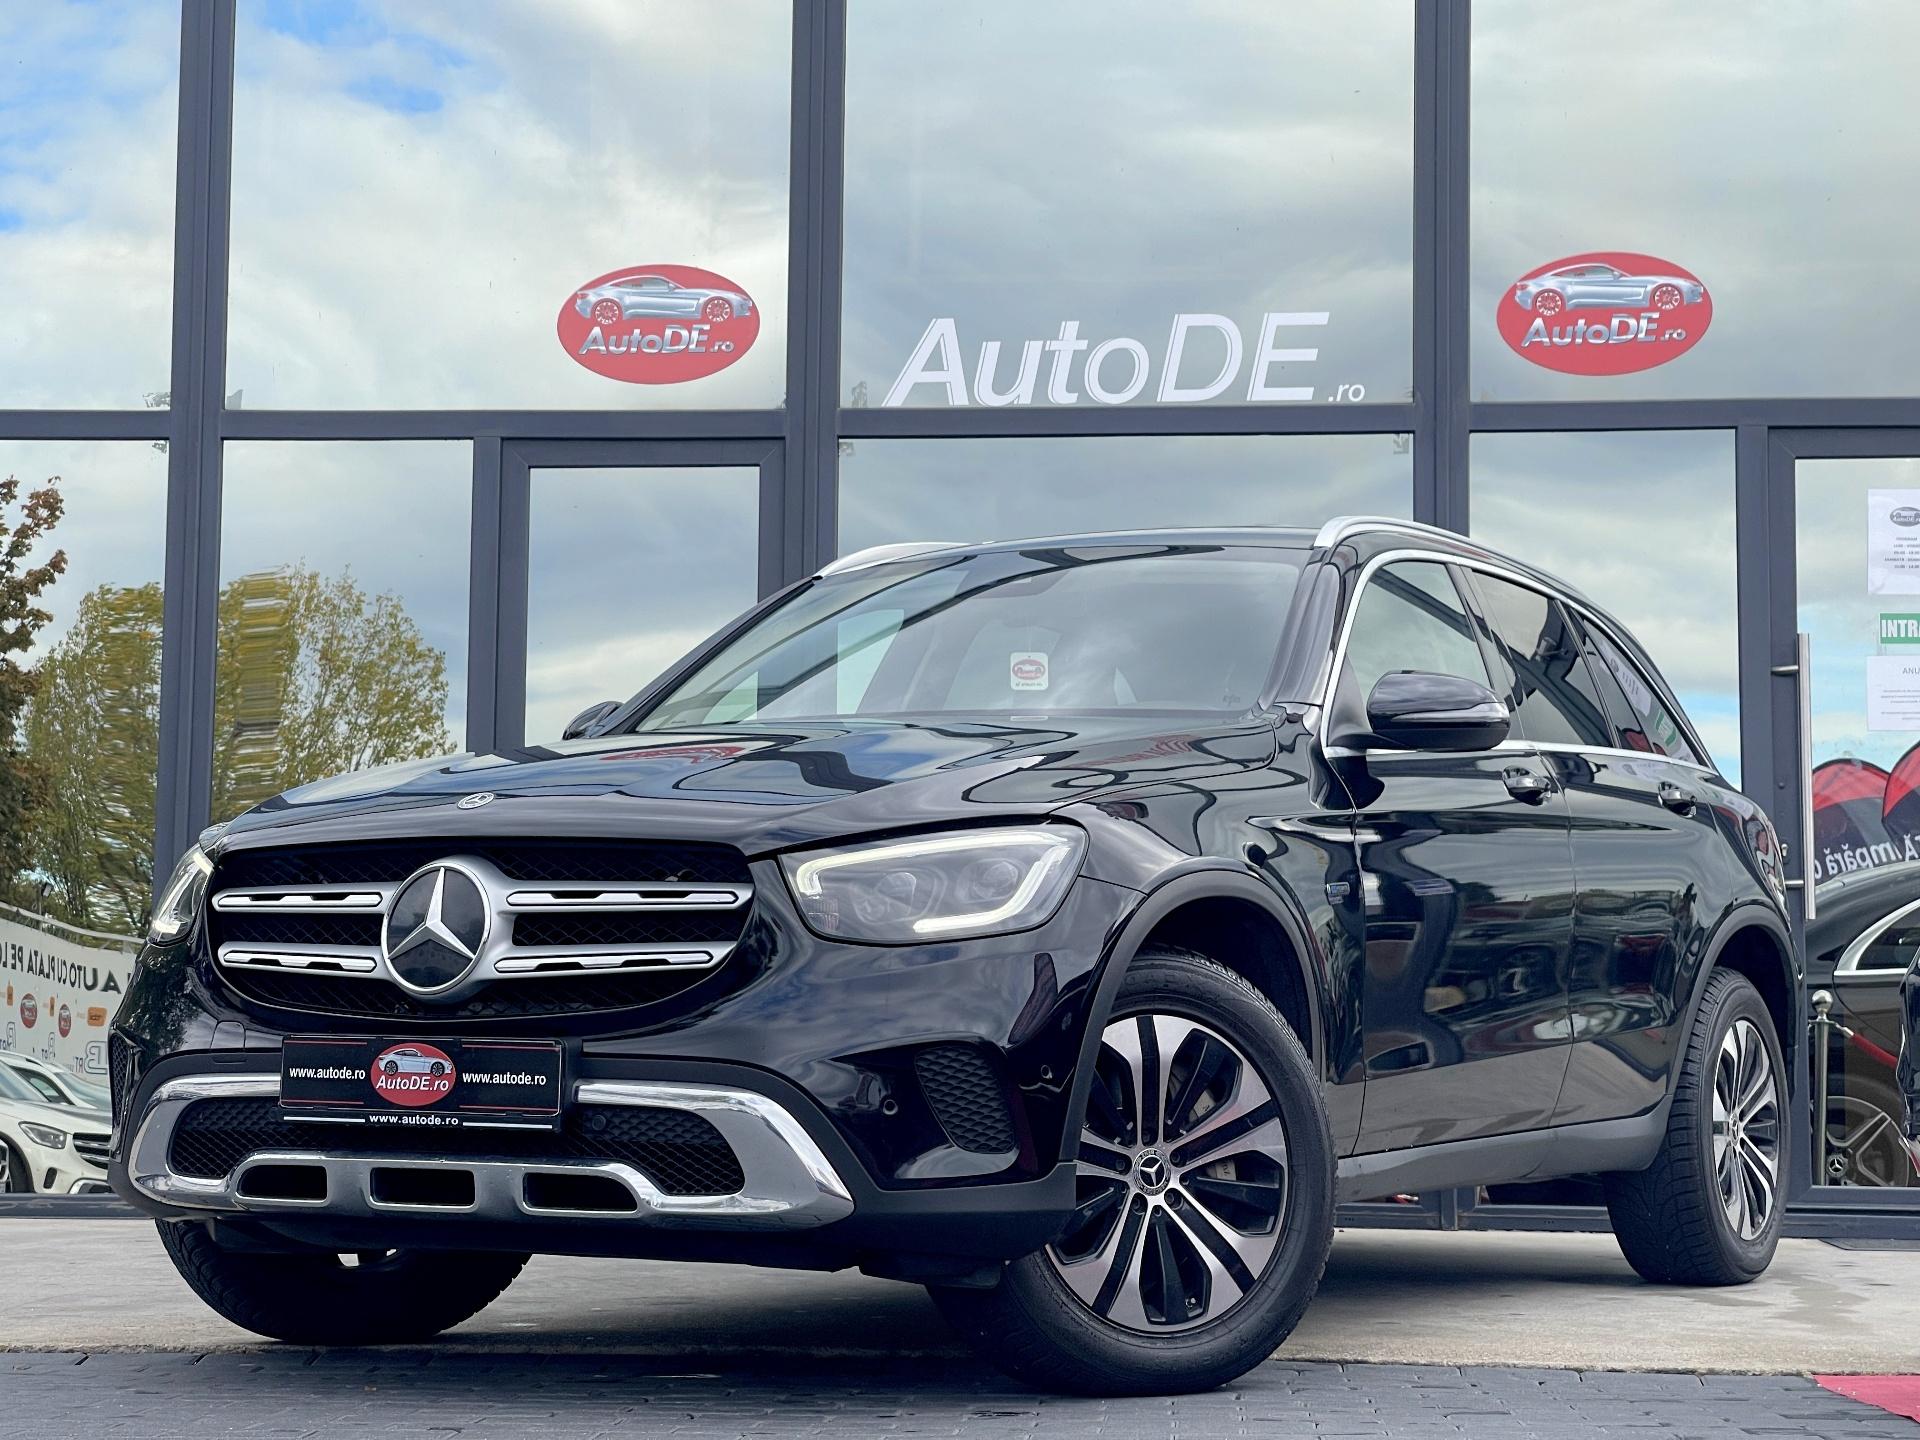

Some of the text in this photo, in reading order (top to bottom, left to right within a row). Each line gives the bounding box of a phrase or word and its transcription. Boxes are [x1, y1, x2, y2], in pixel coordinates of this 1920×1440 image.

[1881, 619, 1920, 638] INTR
[289, 1067, 366, 1080] www.autode.ro
[462, 1072, 546, 1085] www.autode.ro
[376, 1074, 449, 1091] AutoDE.ro
[369, 1113, 459, 1126] www.autode.ro
